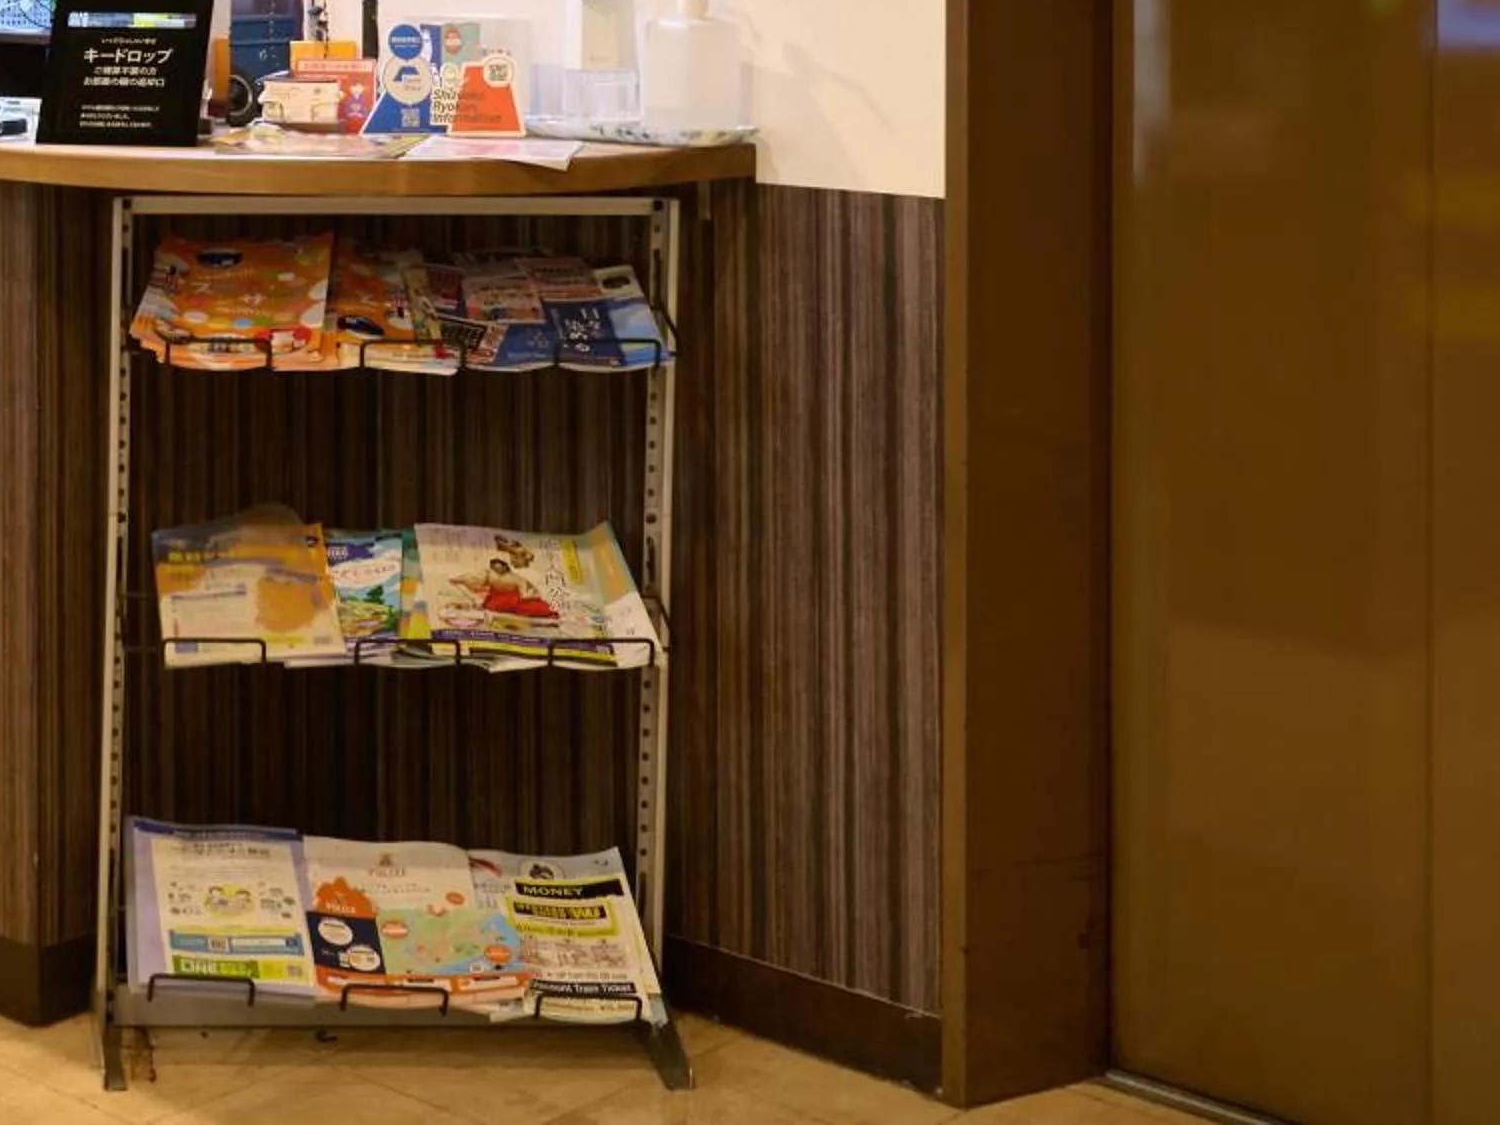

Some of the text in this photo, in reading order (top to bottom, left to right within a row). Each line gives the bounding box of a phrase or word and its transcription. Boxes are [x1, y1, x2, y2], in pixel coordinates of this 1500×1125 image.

[83, 47, 174, 64] キードロップ
[523, 886, 583, 896] MONEY
